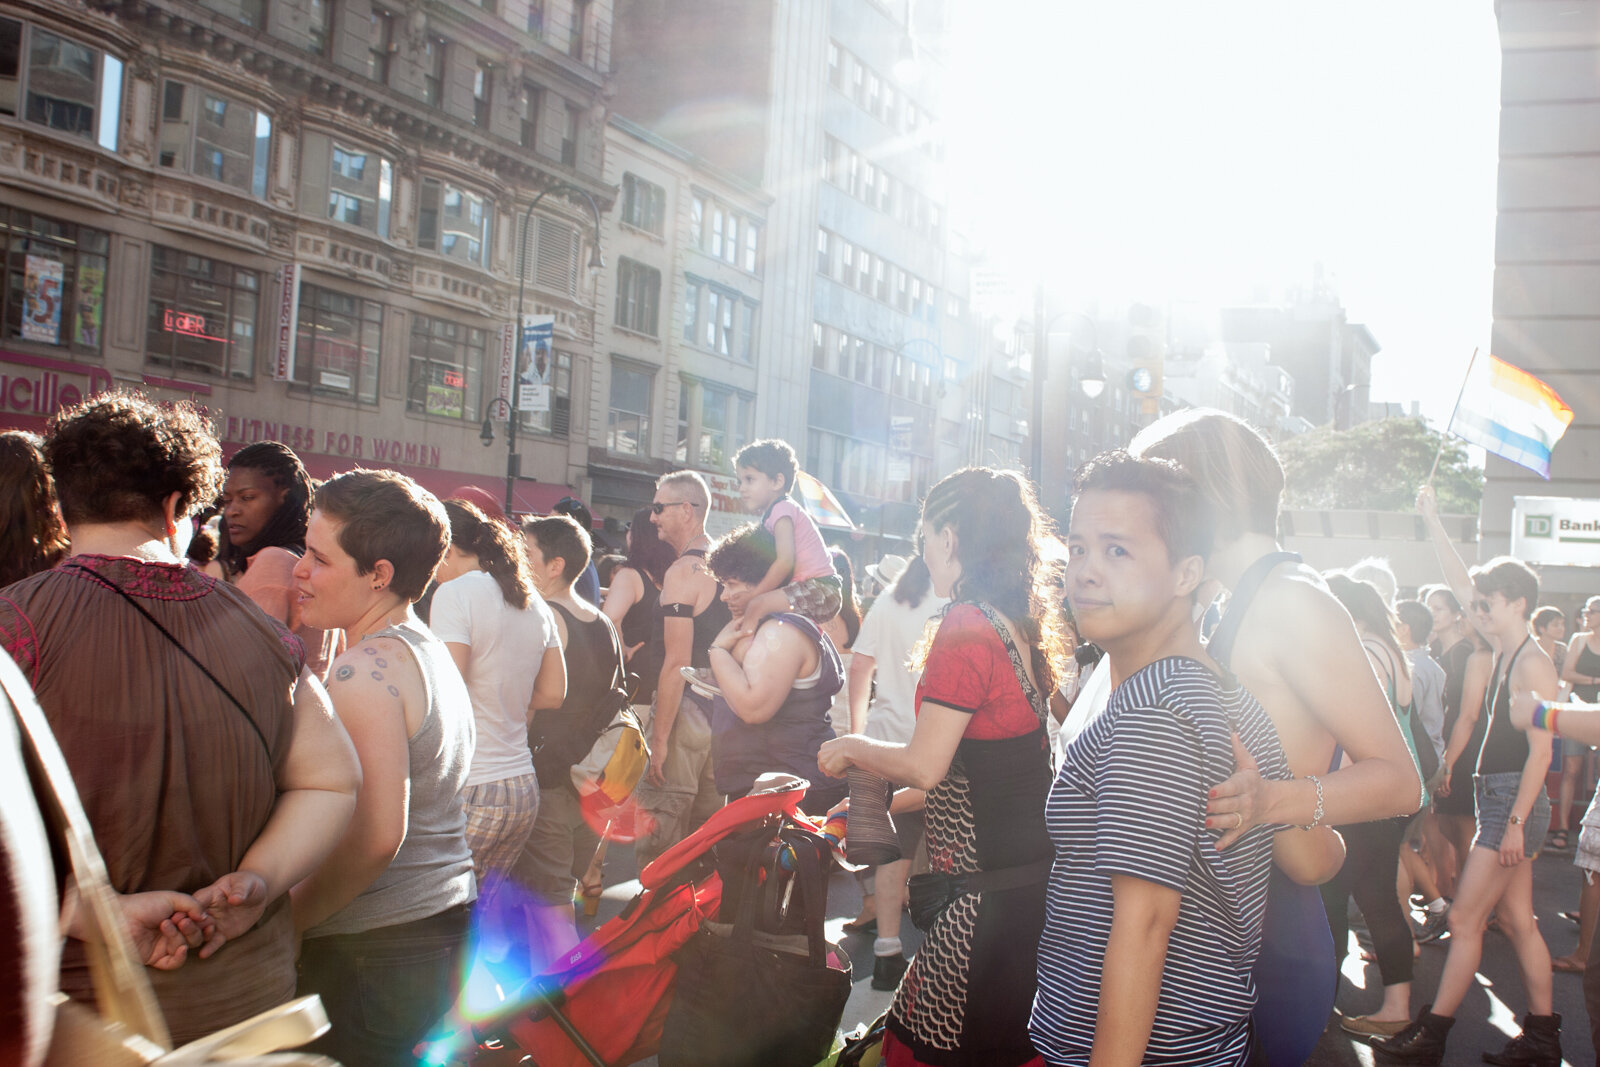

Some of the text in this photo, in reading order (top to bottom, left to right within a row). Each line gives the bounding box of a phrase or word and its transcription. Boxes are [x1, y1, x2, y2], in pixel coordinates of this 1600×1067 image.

[33, 279, 59, 324] 5
[226, 416, 441, 467] FITNESS FOR WOMEN
[1526, 518, 1600, 534] TD Bank
